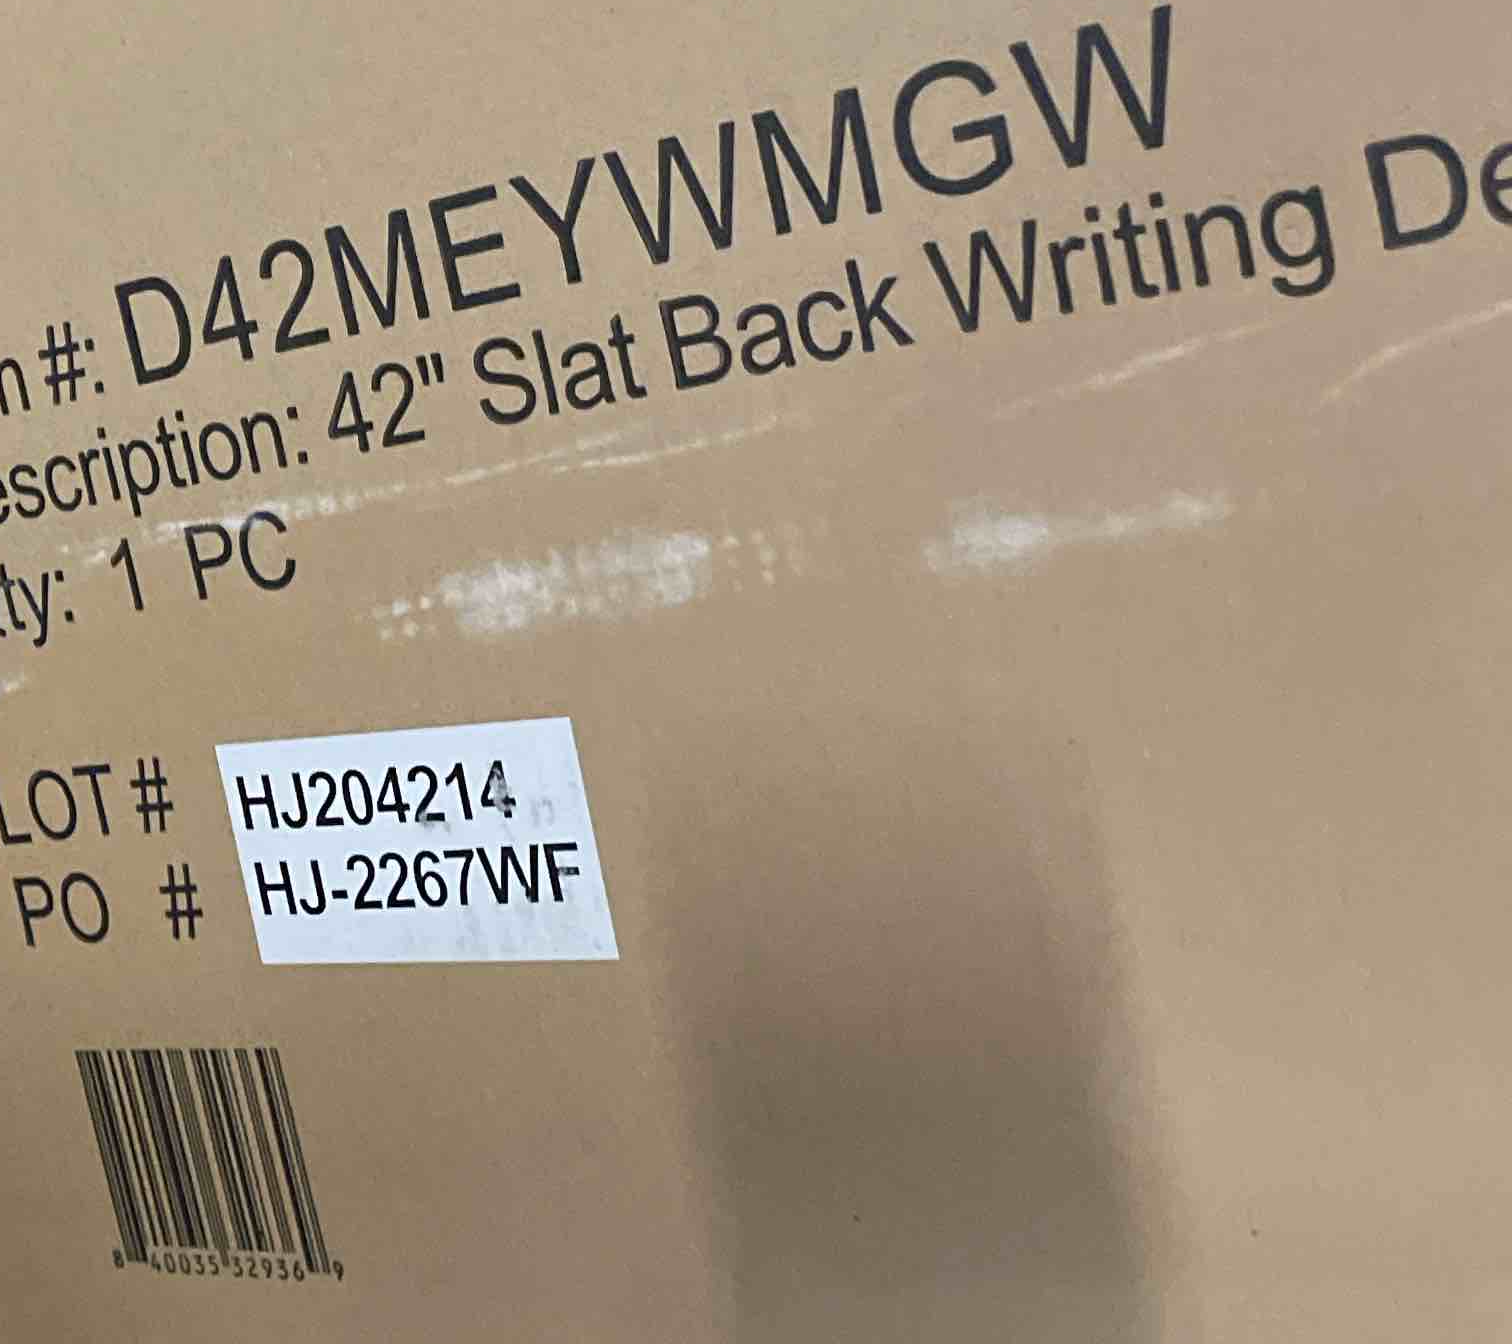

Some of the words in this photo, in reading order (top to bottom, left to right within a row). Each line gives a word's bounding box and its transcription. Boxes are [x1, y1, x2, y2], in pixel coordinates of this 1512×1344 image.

[38, 321, 106, 405] #:
[114, 4, 1172, 385] D42MEYWMGW
[327, 353, 444, 454] 42"
[473, 313, 647, 426] Slat
[660, 259, 916, 390] Back
[923, 185, 1336, 333] Writing
[110, 537, 145, 612] 1
[185, 511, 297, 601] PC
[130, 756, 174, 834] #
[235, 760, 517, 831] HJ204214
[13, 872, 110, 948] PO
[159, 863, 204, 940] #
[253, 841, 581, 917] HJ-2267WF
